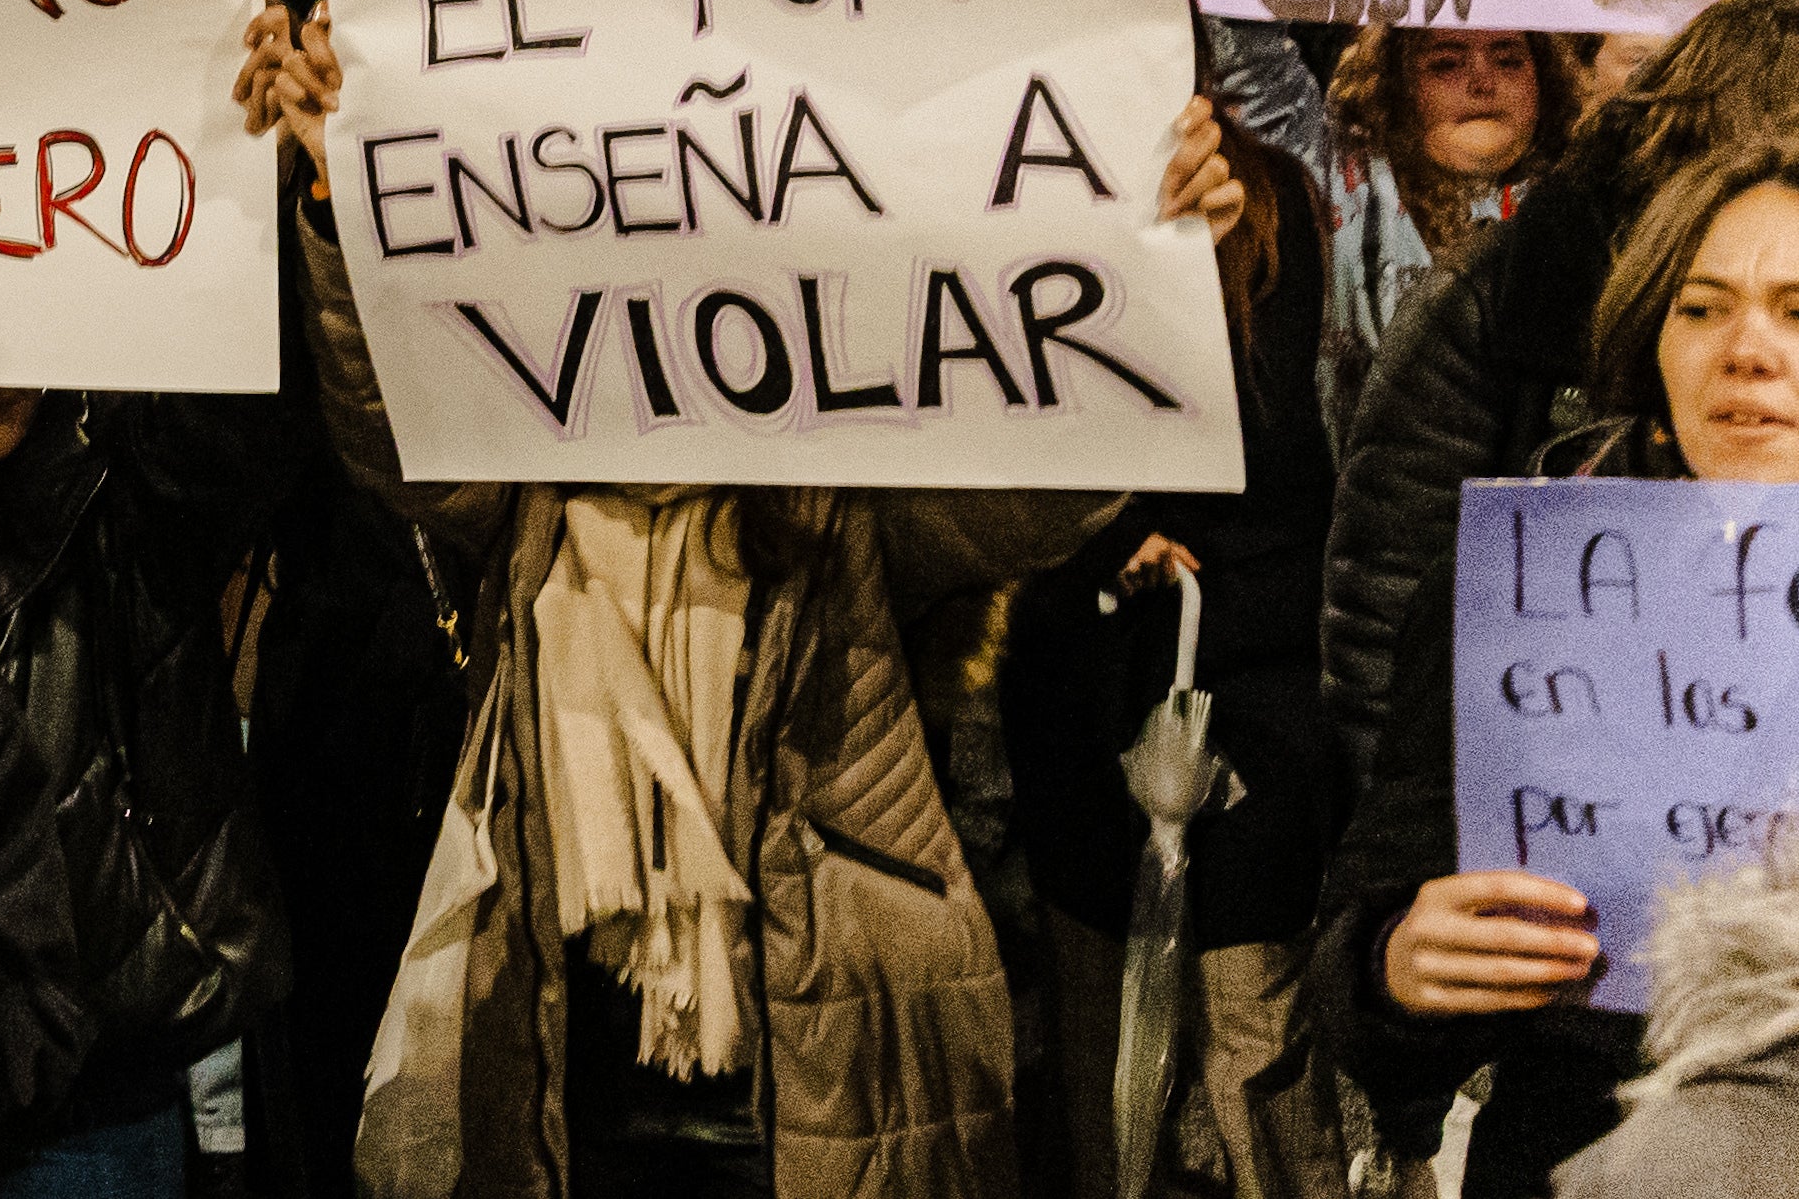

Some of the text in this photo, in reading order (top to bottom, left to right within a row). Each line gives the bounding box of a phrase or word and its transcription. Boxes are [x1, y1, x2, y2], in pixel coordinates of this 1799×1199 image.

[361, 68, 1118, 262] ENSEÑA A
[437, 258, 1191, 442] VIOLAR
[1512, 508, 1642, 620] LA
[1500, 657, 1602, 720] en
